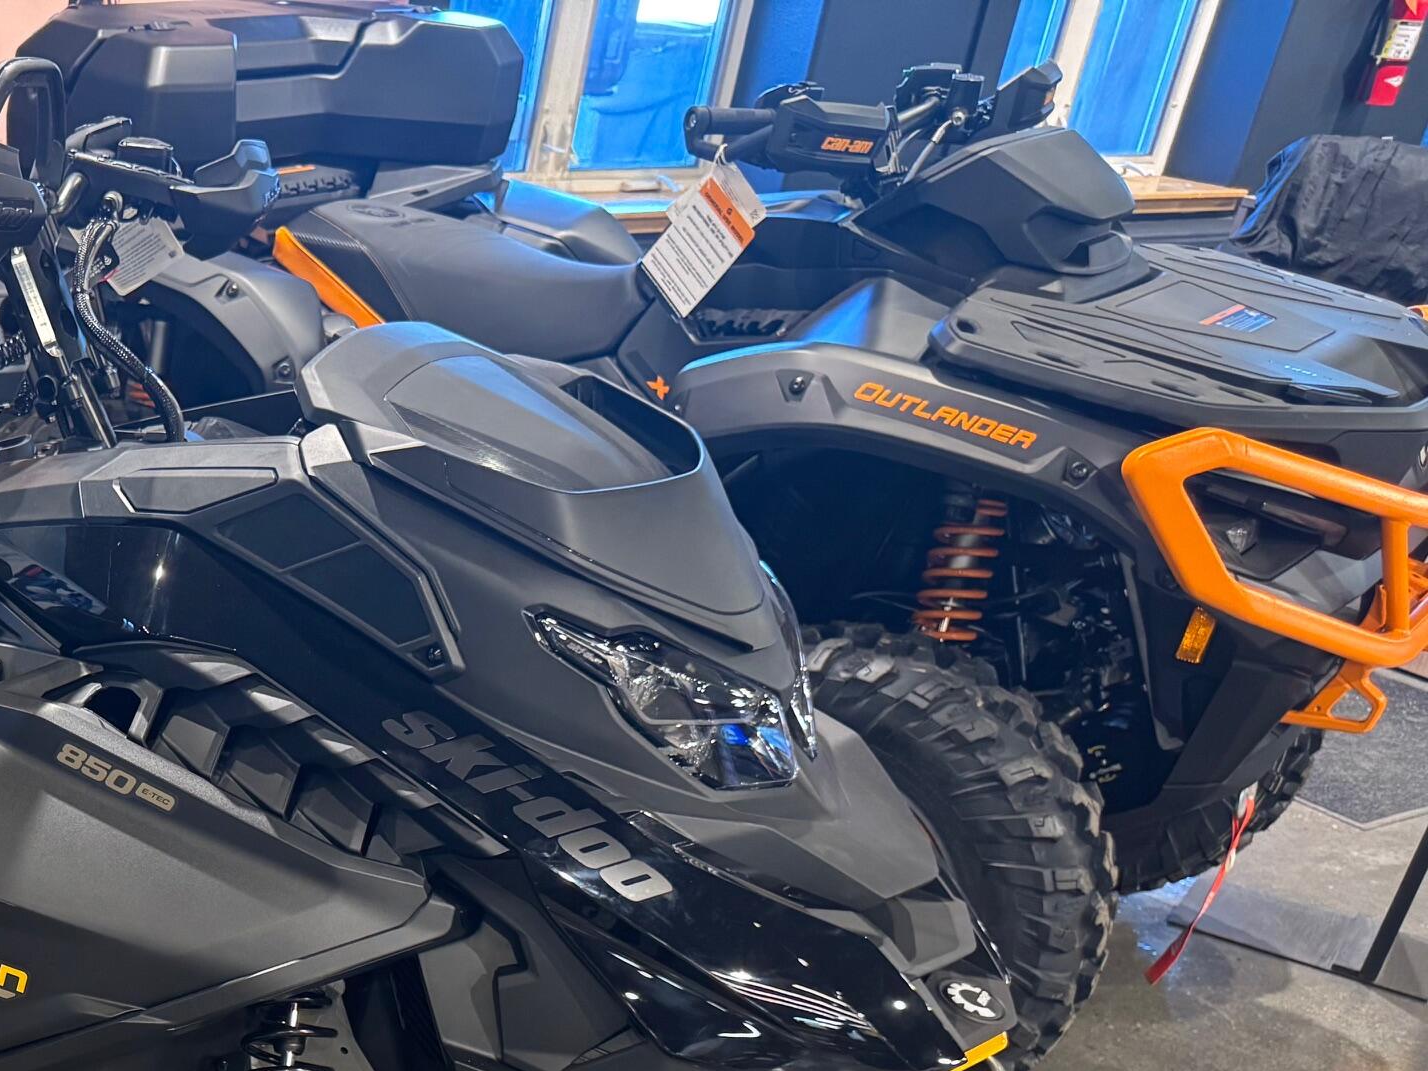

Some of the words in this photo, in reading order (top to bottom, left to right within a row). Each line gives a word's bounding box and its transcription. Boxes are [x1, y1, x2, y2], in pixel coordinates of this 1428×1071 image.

[820, 136, 874, 154] can-am
[853, 382, 1038, 449] OUTLANDER
[56, 743, 137, 795] 850
[141, 788, 171, 806] E-TEC
